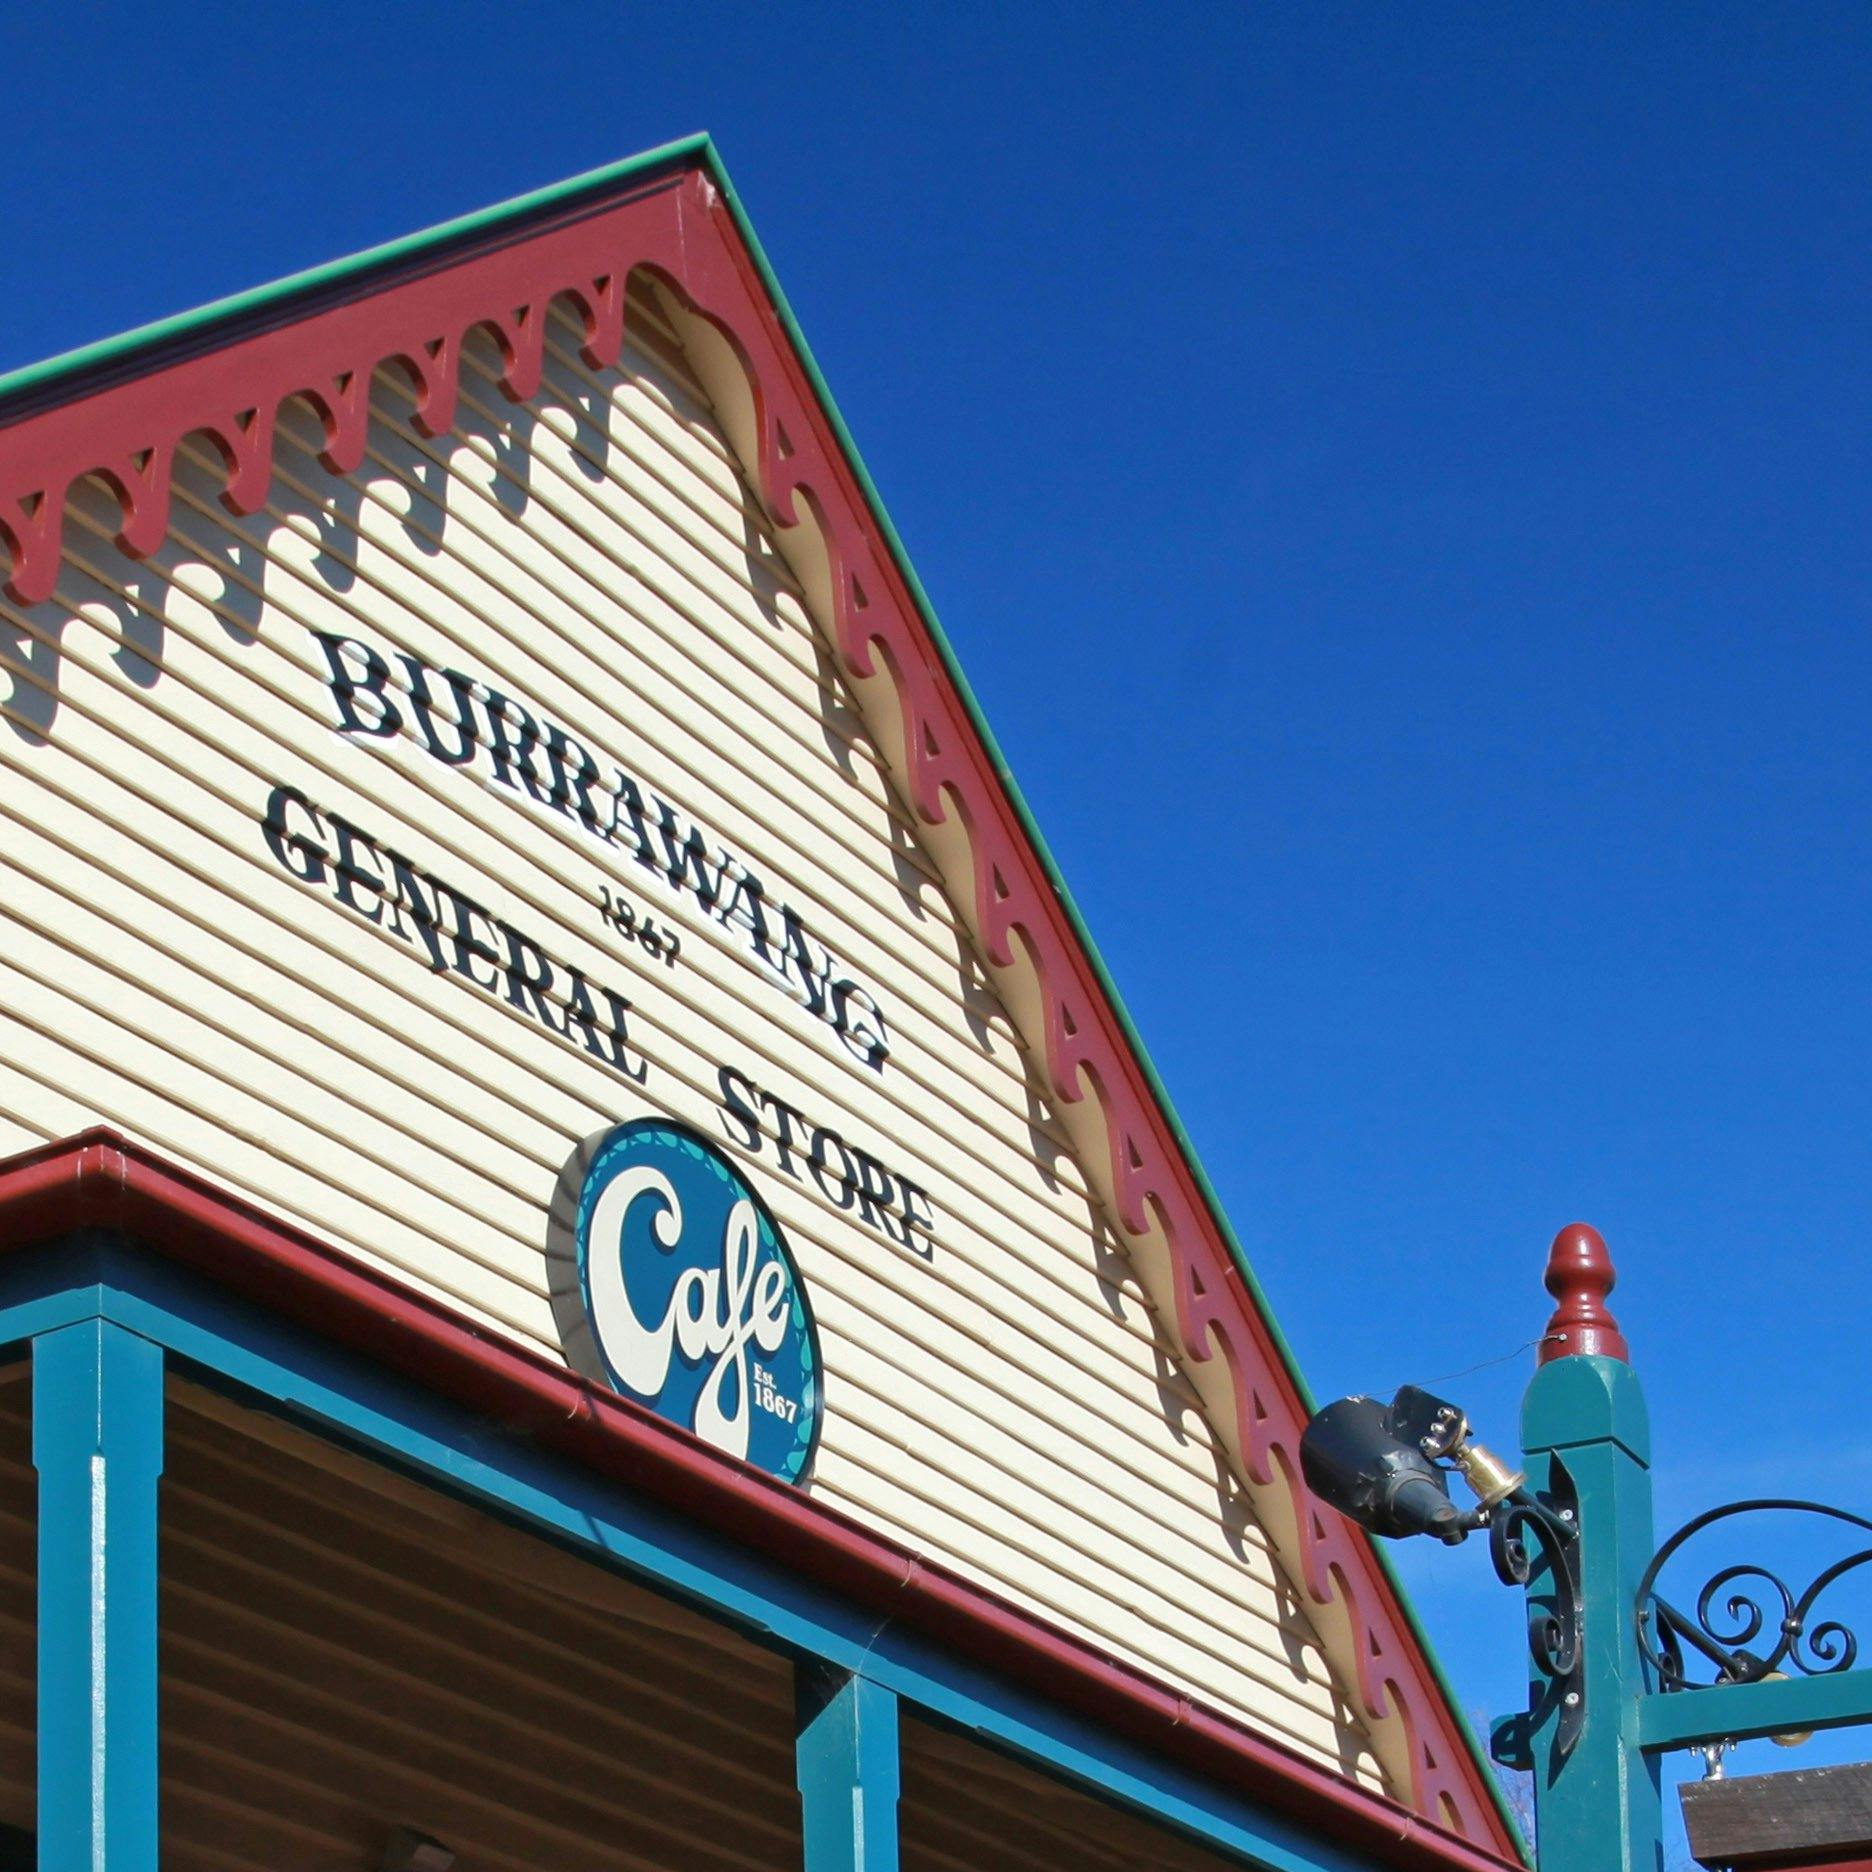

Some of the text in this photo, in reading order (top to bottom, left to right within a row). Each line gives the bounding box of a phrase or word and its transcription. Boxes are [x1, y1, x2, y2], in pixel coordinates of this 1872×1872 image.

[309, 630, 892, 1074] BURRAWANG
[597, 884, 683, 968] 1867
[261, 785, 935, 1263] GENERAL STORE
[753, 1362, 777, 1389] Est.
[754, 1382, 798, 1424] 1867
